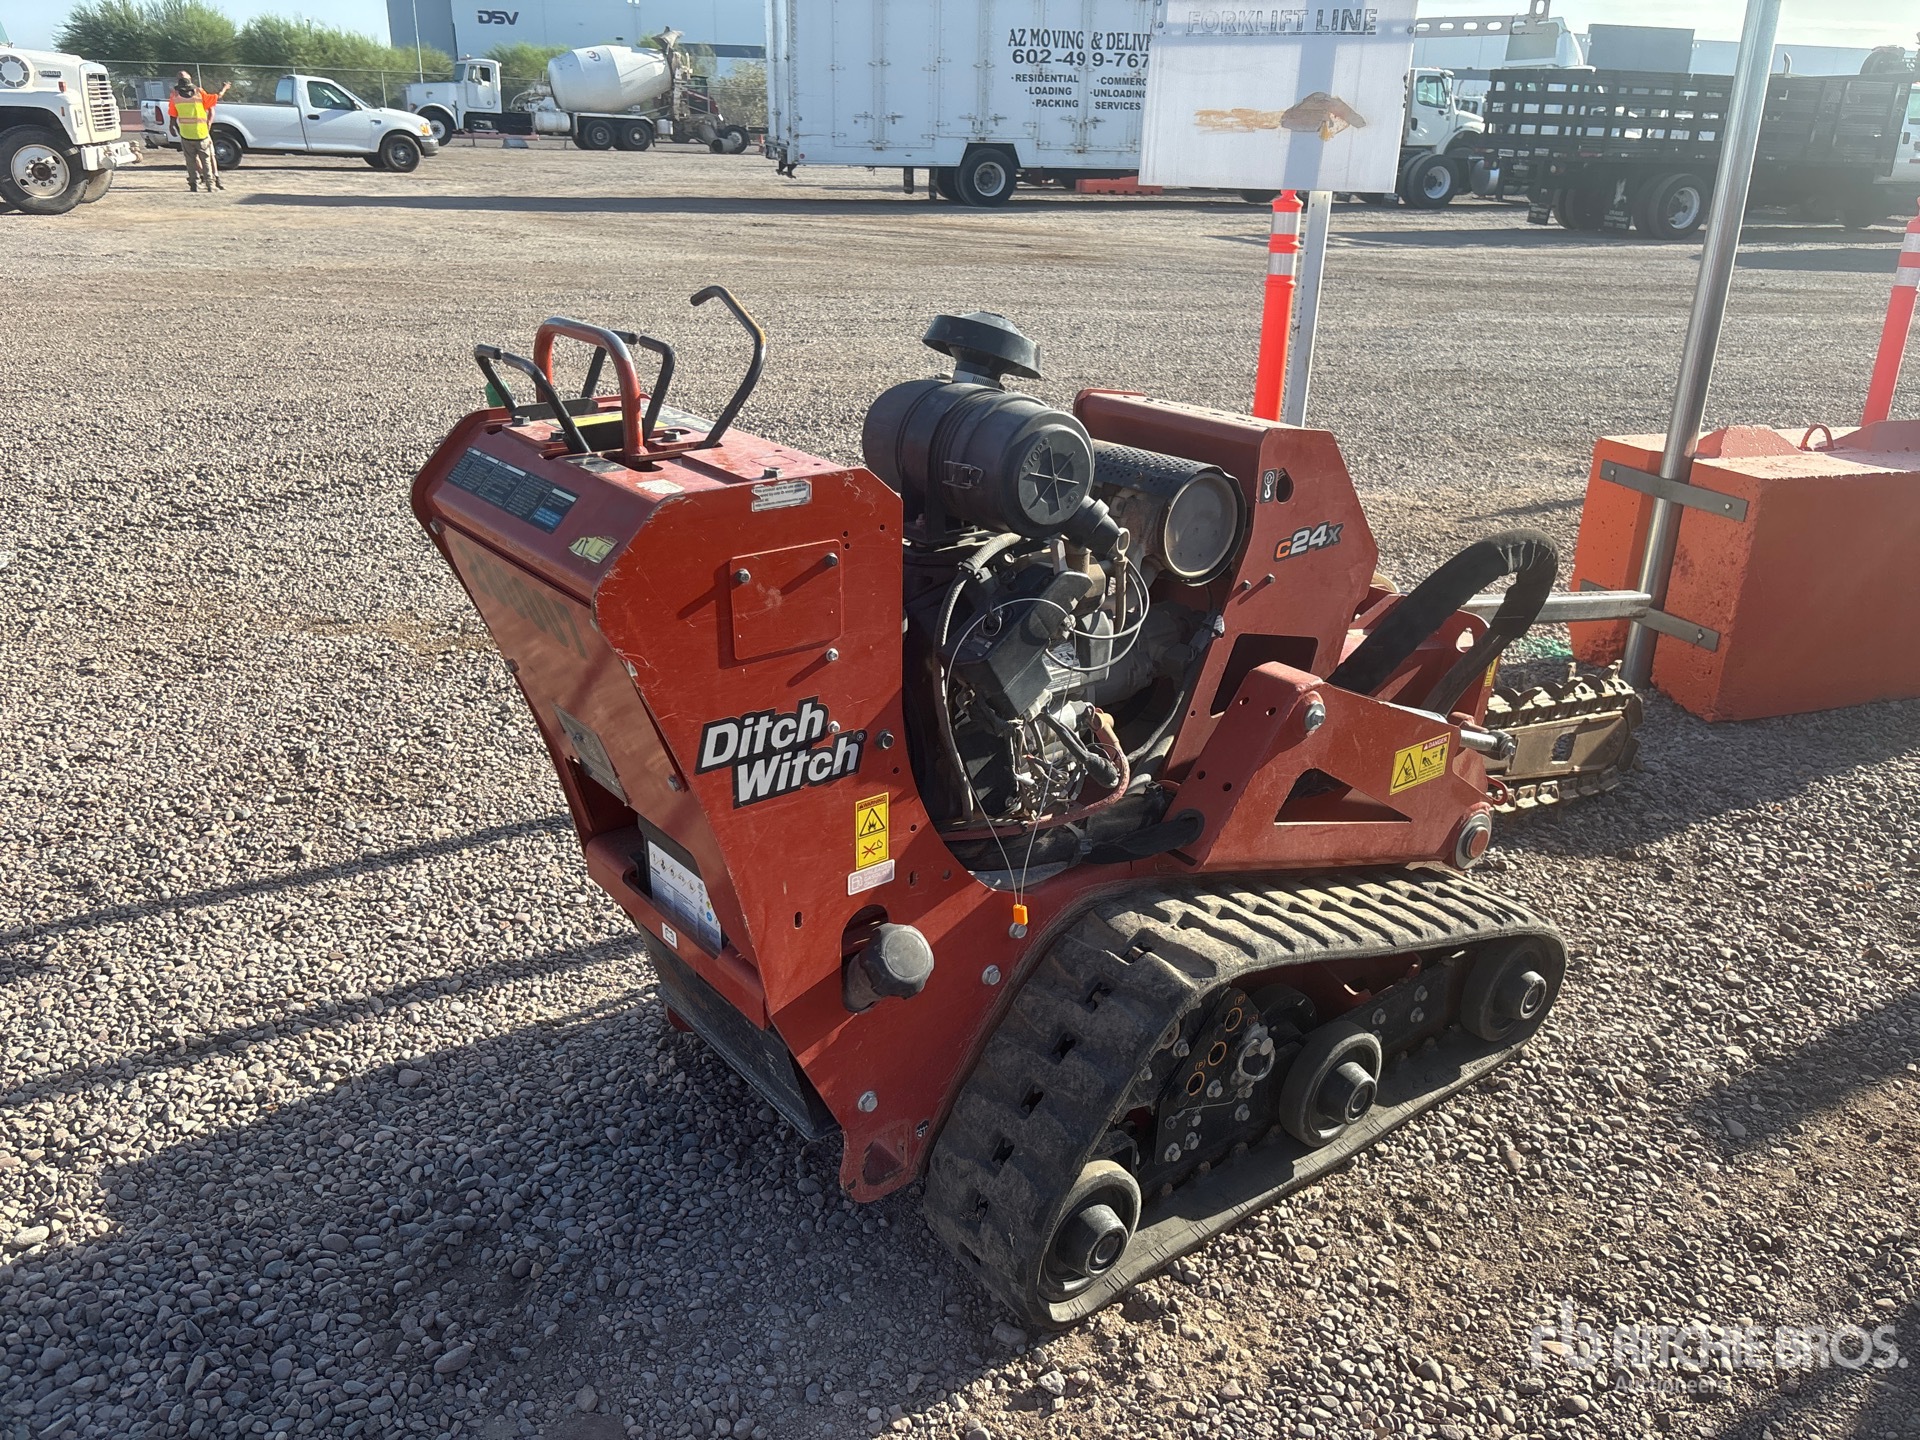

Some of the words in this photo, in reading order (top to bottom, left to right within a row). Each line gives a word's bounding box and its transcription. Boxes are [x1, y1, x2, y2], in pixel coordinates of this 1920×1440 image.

[477, 10, 519, 25] DSV
[1188, 10, 1309, 33] FORKLIFT
[1316, 9, 1378, 31] LINE
[1008, 28, 1027, 47] AZ
[1030, 29, 1084, 50] MOVING
[1091, 32, 1103, 50] &
[1029, 87, 1072, 96] LOADING
[1036, 100, 1079, 108] PACKING
[1095, 102, 1141, 110] SERVICES
[701, 702, 825, 769] Ditch
[1428, 736, 1448, 749] DANGER
